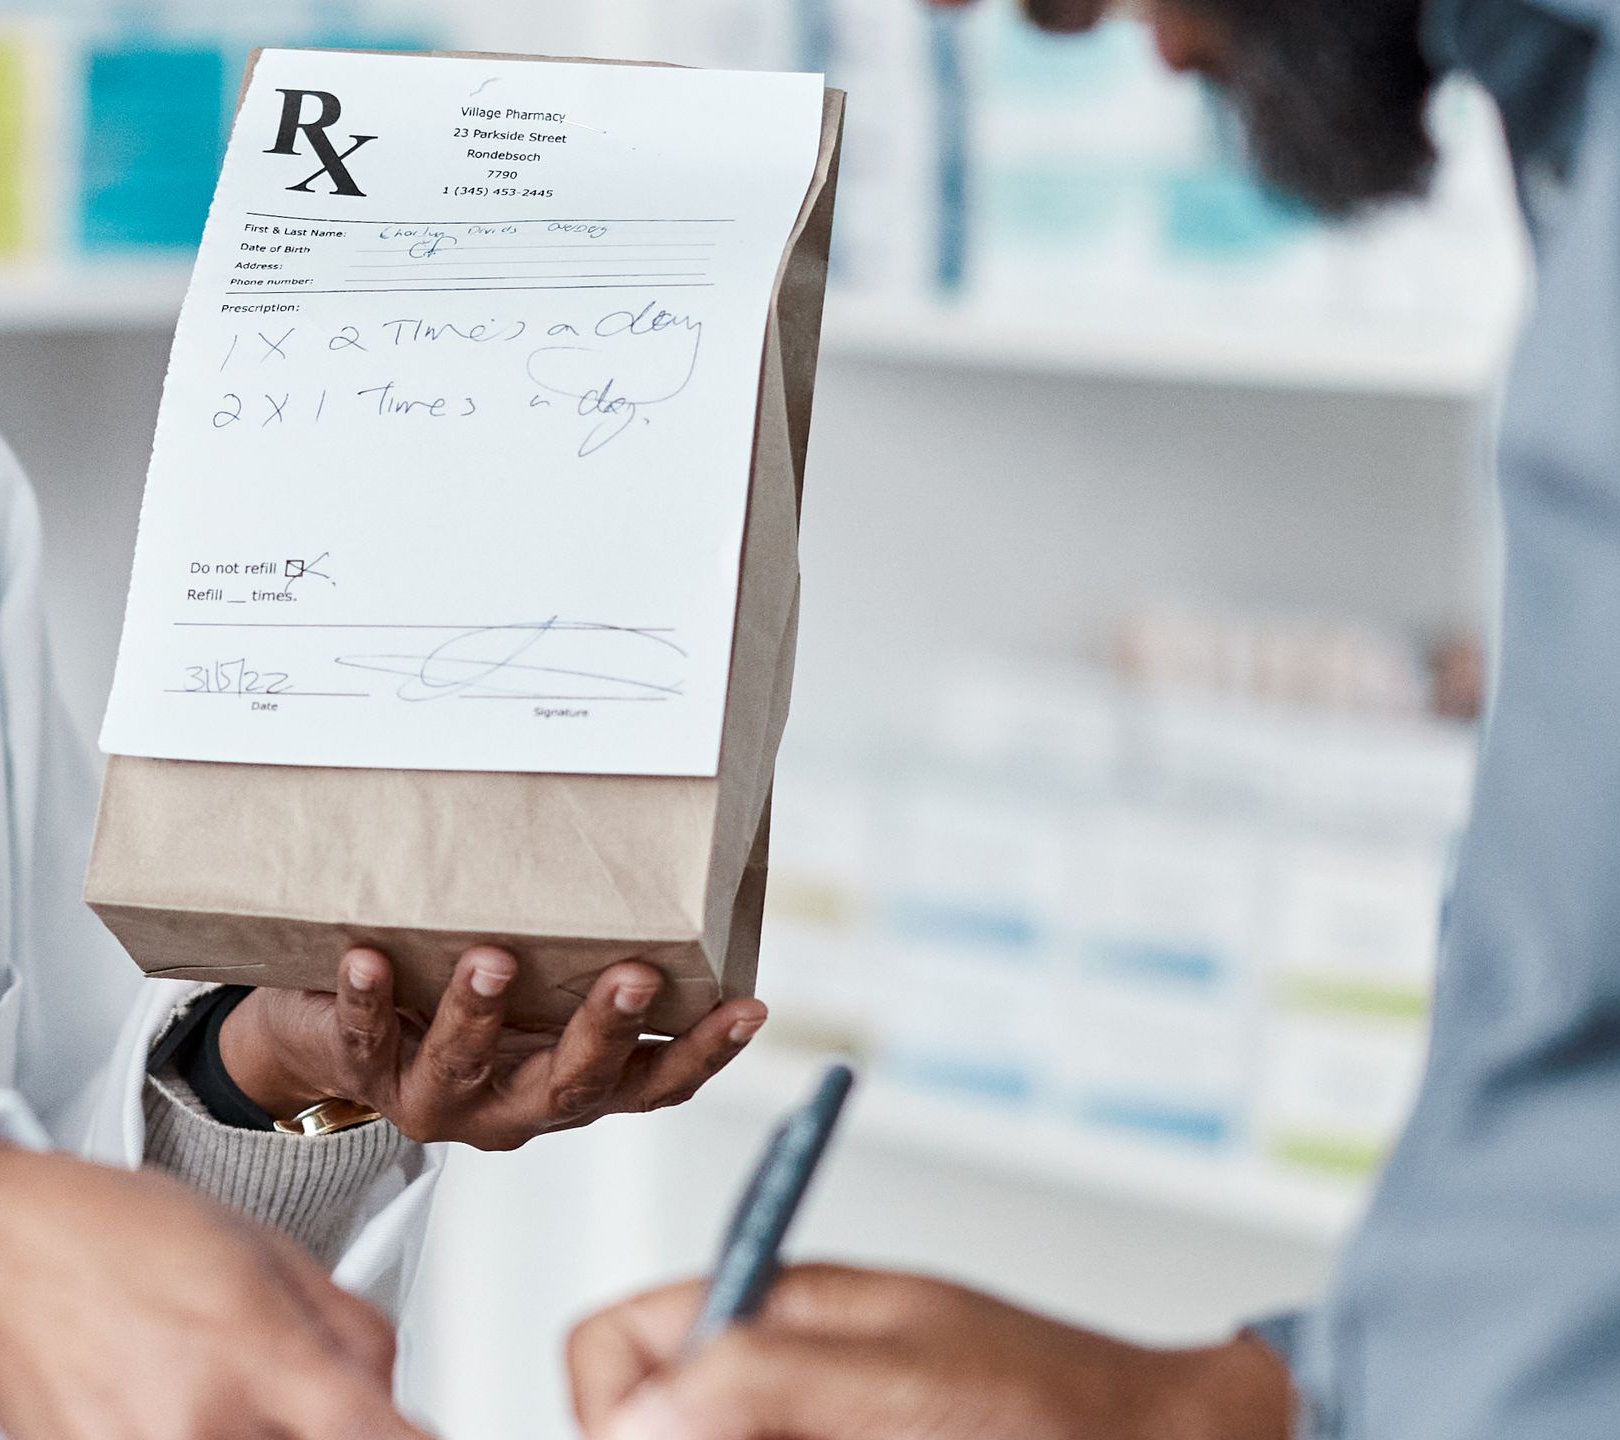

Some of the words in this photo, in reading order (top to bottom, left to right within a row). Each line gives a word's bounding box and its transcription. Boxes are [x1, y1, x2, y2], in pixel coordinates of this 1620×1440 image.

[461, 107, 501, 120] Village
[505, 109, 566, 123] Pharmacy
[453, 127, 469, 138] 23
[473, 129, 525, 141] Parkside
[529, 132, 567, 144] Street
[466, 149, 541, 162] Rondebsoch
[487, 169, 518, 180] 7790
[442, 186, 449, 195] 1
[454, 186, 489, 198] (345)
[492, 188, 554, 198] 453-2445
[244, 223, 269, 234] First
[272, 226, 281, 235] &
[284, 227, 308, 237] Last
[310, 229, 347, 238] Name:
[240, 242, 267, 253] Date
[270, 245, 282, 253] of
[284, 245, 311, 254] Birth
[234, 261, 283, 270] Address:
[230, 278, 264, 286] Phone
[266, 278, 314, 286] number:
[221, 304, 300, 314] Prescription:
[213, 393, 242, 428] 2
[190, 562, 211, 574] Do
[216, 562, 239, 574] not
[244, 562, 277, 574] refill
[187, 589, 223, 601] Refill
[252, 590, 297, 602] times.
[251, 701, 278, 712] Date
[533, 706, 589, 720] Signature
